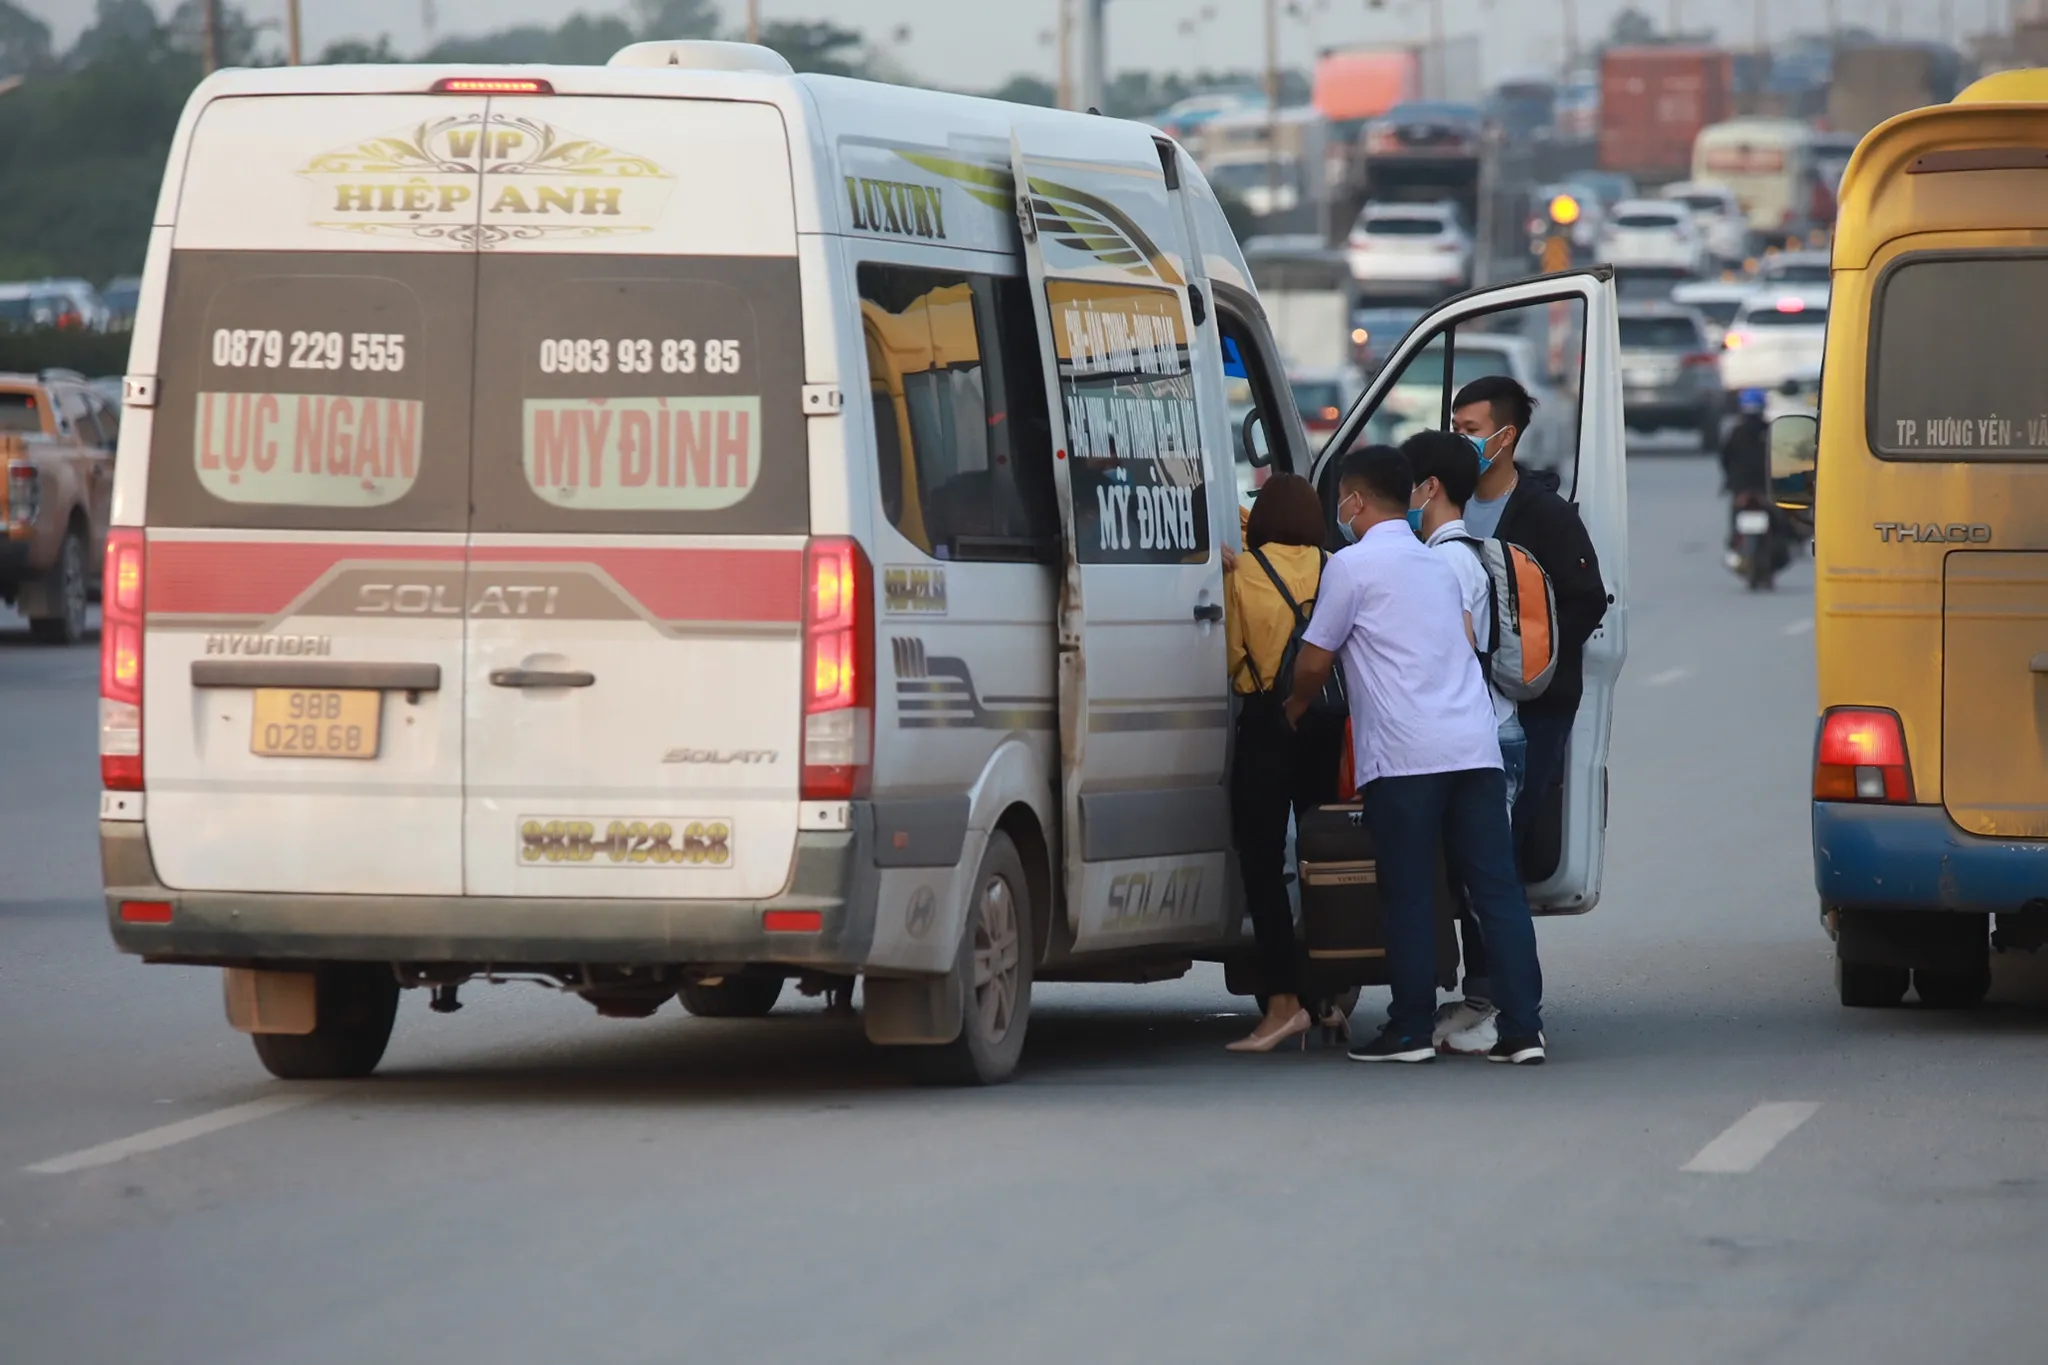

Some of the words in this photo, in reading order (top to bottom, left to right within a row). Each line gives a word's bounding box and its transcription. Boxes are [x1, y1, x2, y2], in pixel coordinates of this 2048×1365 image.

[447, 131, 524, 159] VIP
[333, 177, 471, 220] HIỆP
[488, 185, 622, 215] ANH
[844, 176, 946, 239] LUXURY
[212, 329, 283, 368] 0879
[289, 331, 344, 370] 229
[350, 333, 405, 372] 555
[540, 339, 609, 374] 0983
[617, 339, 653, 374] 93
[660, 339, 697, 374] 83
[704, 339, 741, 374] 85
[201, 393, 279, 485] LỤC
[293, 396, 417, 490] NGẠN
[534, 398, 613, 488] MỸ
[617, 398, 749, 488] ĐÌNH
[1897, 420, 1919, 446] TP.
[1927, 417, 1973, 446] HƯNG
[1978, 413, 2011, 446] YÊN
[1097, 466, 1131, 550] MỸ
[1136, 466, 1196, 550] ĐÌNH
[1874, 522, 1991, 543] THACO
[354, 584, 559, 614] SOLATI
[205, 634, 331, 656] HYUNDAI
[289, 693, 341, 719] 98B
[265, 724, 362, 751] 028.68
[660, 747, 779, 764] SOLATI
[522, 820, 729, 864] 98B-028.68
[1102, 866, 1204, 929] SOLATI
